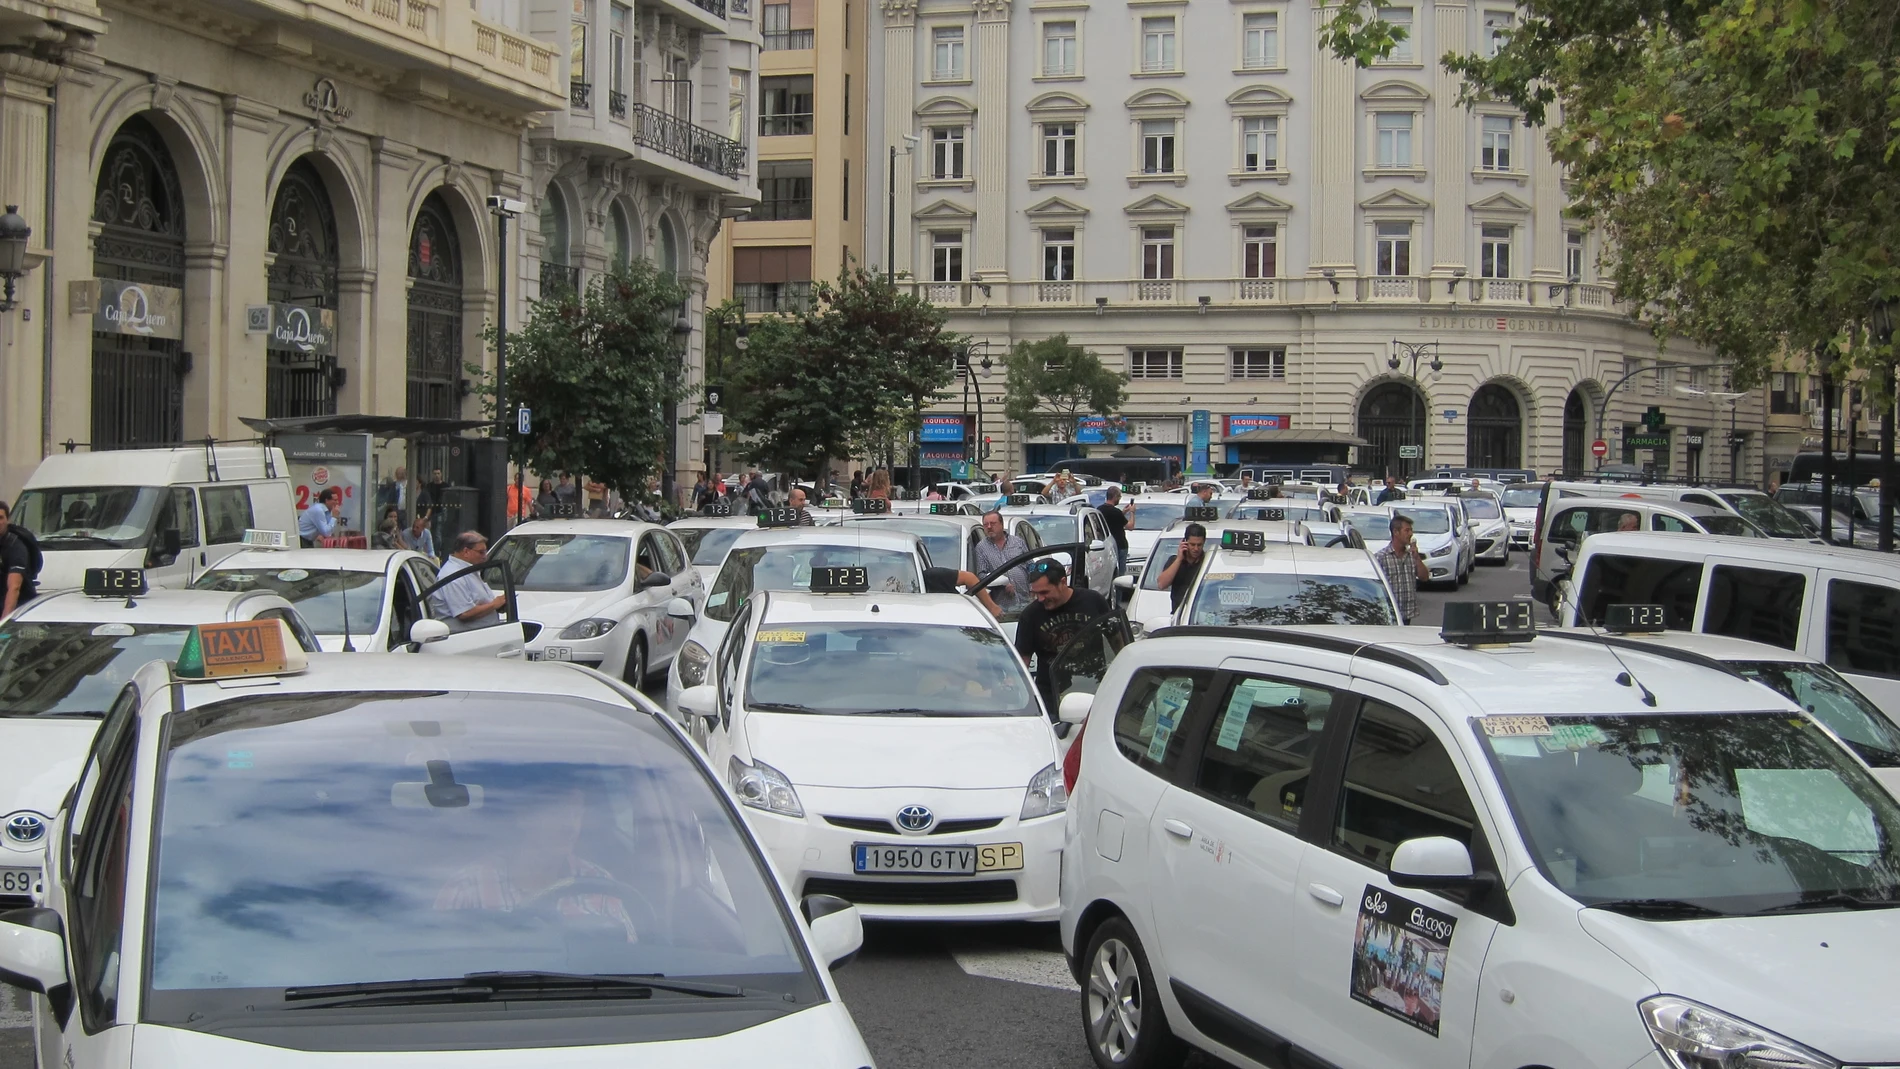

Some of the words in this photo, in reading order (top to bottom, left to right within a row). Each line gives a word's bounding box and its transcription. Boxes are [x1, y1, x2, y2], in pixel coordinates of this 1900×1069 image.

[105, 304, 127, 325] Caja
[120, 286, 166, 333] Duero
[275, 325, 294, 344] Caja
[287, 308, 325, 352] Duero
[1419, 316, 1495, 330] EDIFICIO
[1508, 319, 1577, 333] GENERALI
[1626, 437, 1668, 446] FARMACIA
[1013, 495, 1028, 503] 123
[1253, 489, 1269, 498] 123
[553, 504, 573, 515] 123
[711, 505, 730, 514] 123
[863, 499, 884, 509] 123
[937, 504, 955, 512] 123
[769, 508, 797, 522] 123
[1194, 507, 1216, 517] 123
[1265, 509, 1283, 518] 123
[252, 532, 273, 544] TAXI
[1234, 532, 1262, 547] 123
[102, 570, 141, 588] 123
[827, 568, 865, 586] 123
[1223, 592, 1250, 603] OCUPADO
[1479, 603, 1530, 630] 123
[1629, 607, 1664, 625] 123
[204, 627, 261, 656] TAXI
[214, 655, 253, 663] VALENCIA
[548, 648, 568, 659] SP
[1485, 724, 1524, 735] V-101
[872, 849, 923, 869] 1950
[930, 850, 970, 870] GTV
[981, 846, 1016, 868] SP
[2, 871, 30, 892] 69
